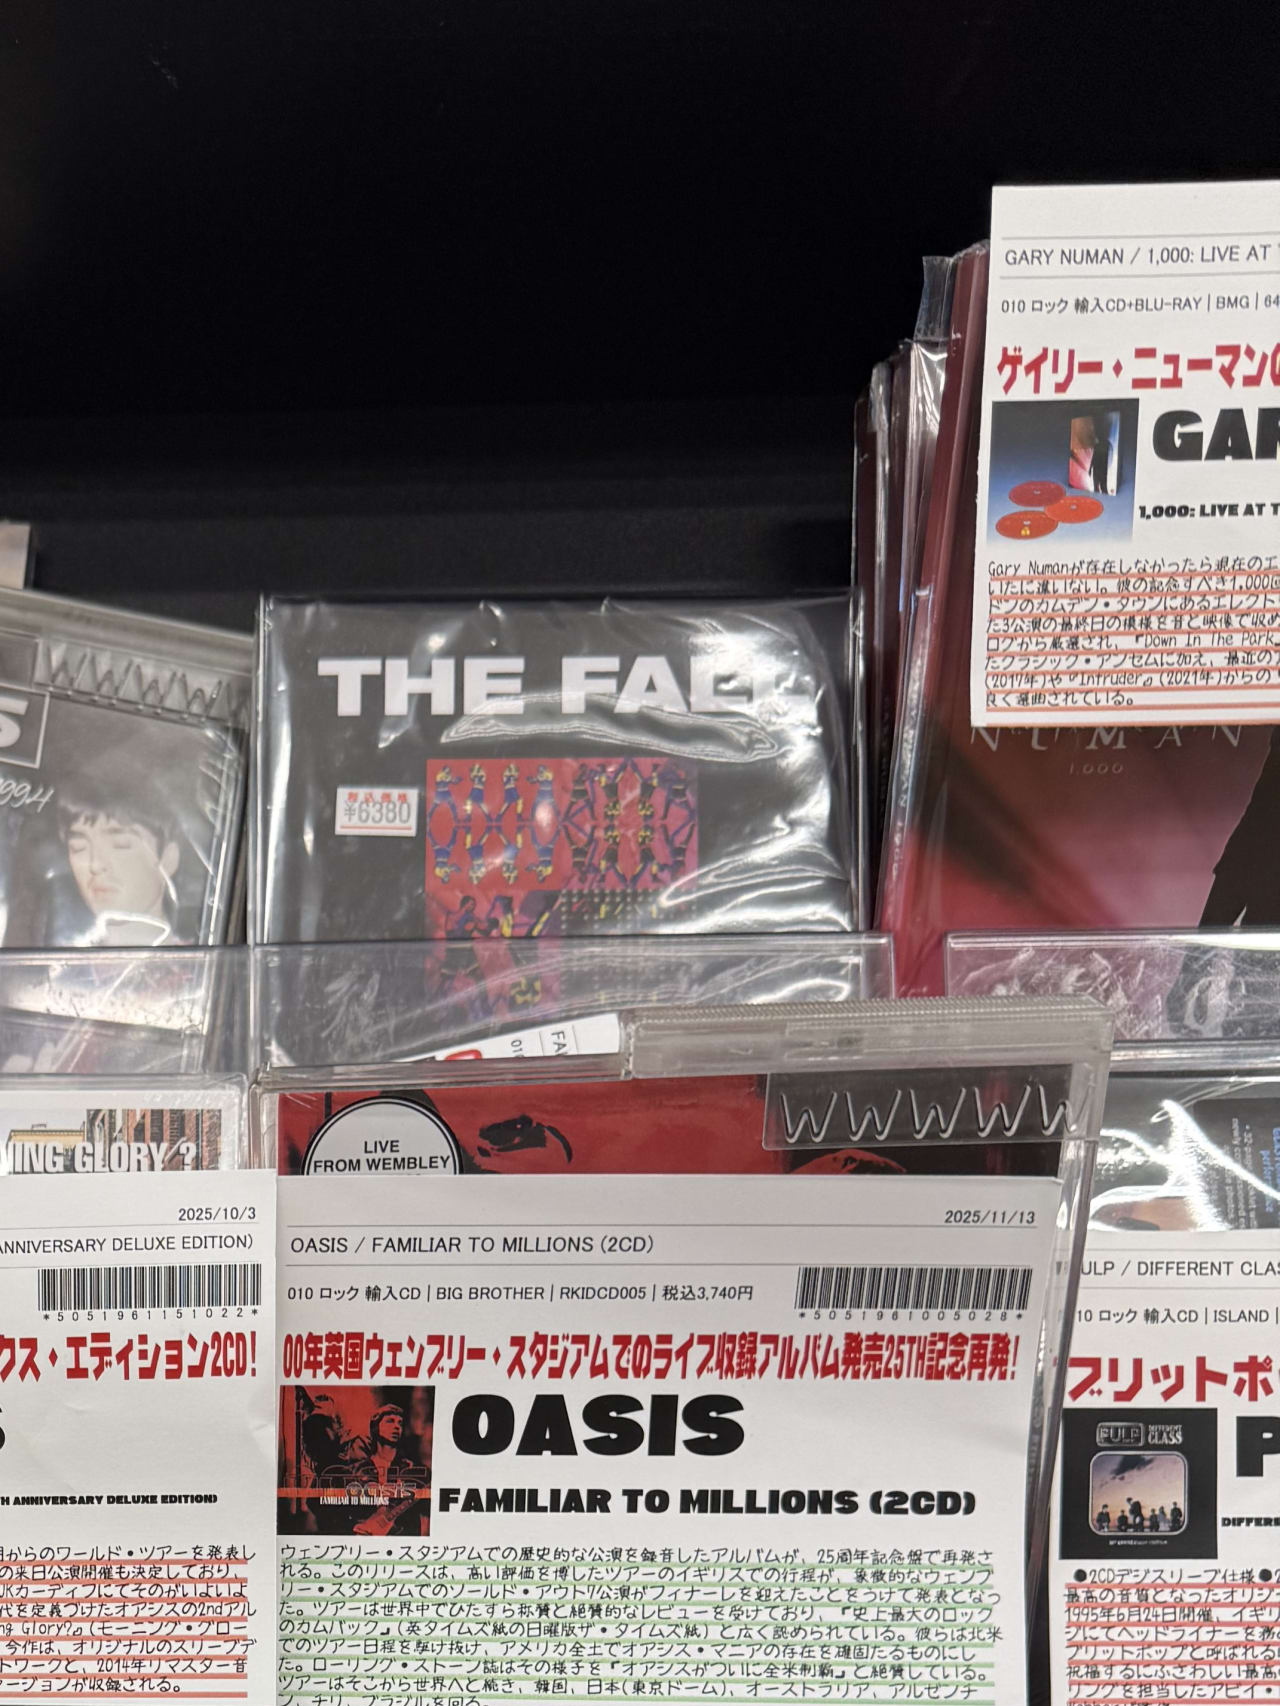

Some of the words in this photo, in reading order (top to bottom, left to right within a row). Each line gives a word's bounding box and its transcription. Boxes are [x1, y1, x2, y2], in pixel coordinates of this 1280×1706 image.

[1005, 249, 1053, 265] GARY
[1061, 249, 1123, 264] NUMAN
[1150, 247, 1193, 265] 1,000:
[1201, 246, 1239, 262] LIVE
[1246, 245, 1271, 261] AT
[1217, 296, 1249, 309] BMG
[989, 561, 1023, 580] Gary
[317, 656, 525, 716] THE
[345, 800, 410, 825] ¥6380
[363, 1139, 400, 1155] LIVE
[73, 1140, 168, 1174] GLORY
[313, 1158, 362, 1174] FROM
[366, 1155, 451, 1173] WEMBLEY
[179, 1207, 255, 1221] 2025/10/3
[945, 1210, 1035, 1224] 2025/11/13
[113, 1237, 175, 1251] DELUXE
[182, 1234, 252, 1249] EDITION)
[1138, 1261, 1233, 1275] DIFFERENT
[560, 1287, 646, 1299] RKIDCD005
[1214, 1310, 1269, 1322] ISLAND
[452, 1394, 744, 1456] OASIS
[439, 1488, 611, 1513] FAMILIAR
[622, 1489, 669, 1513] TO
[680, 1490, 858, 1514] MILLIONS
[870, 1491, 975, 1515] (2CD)
